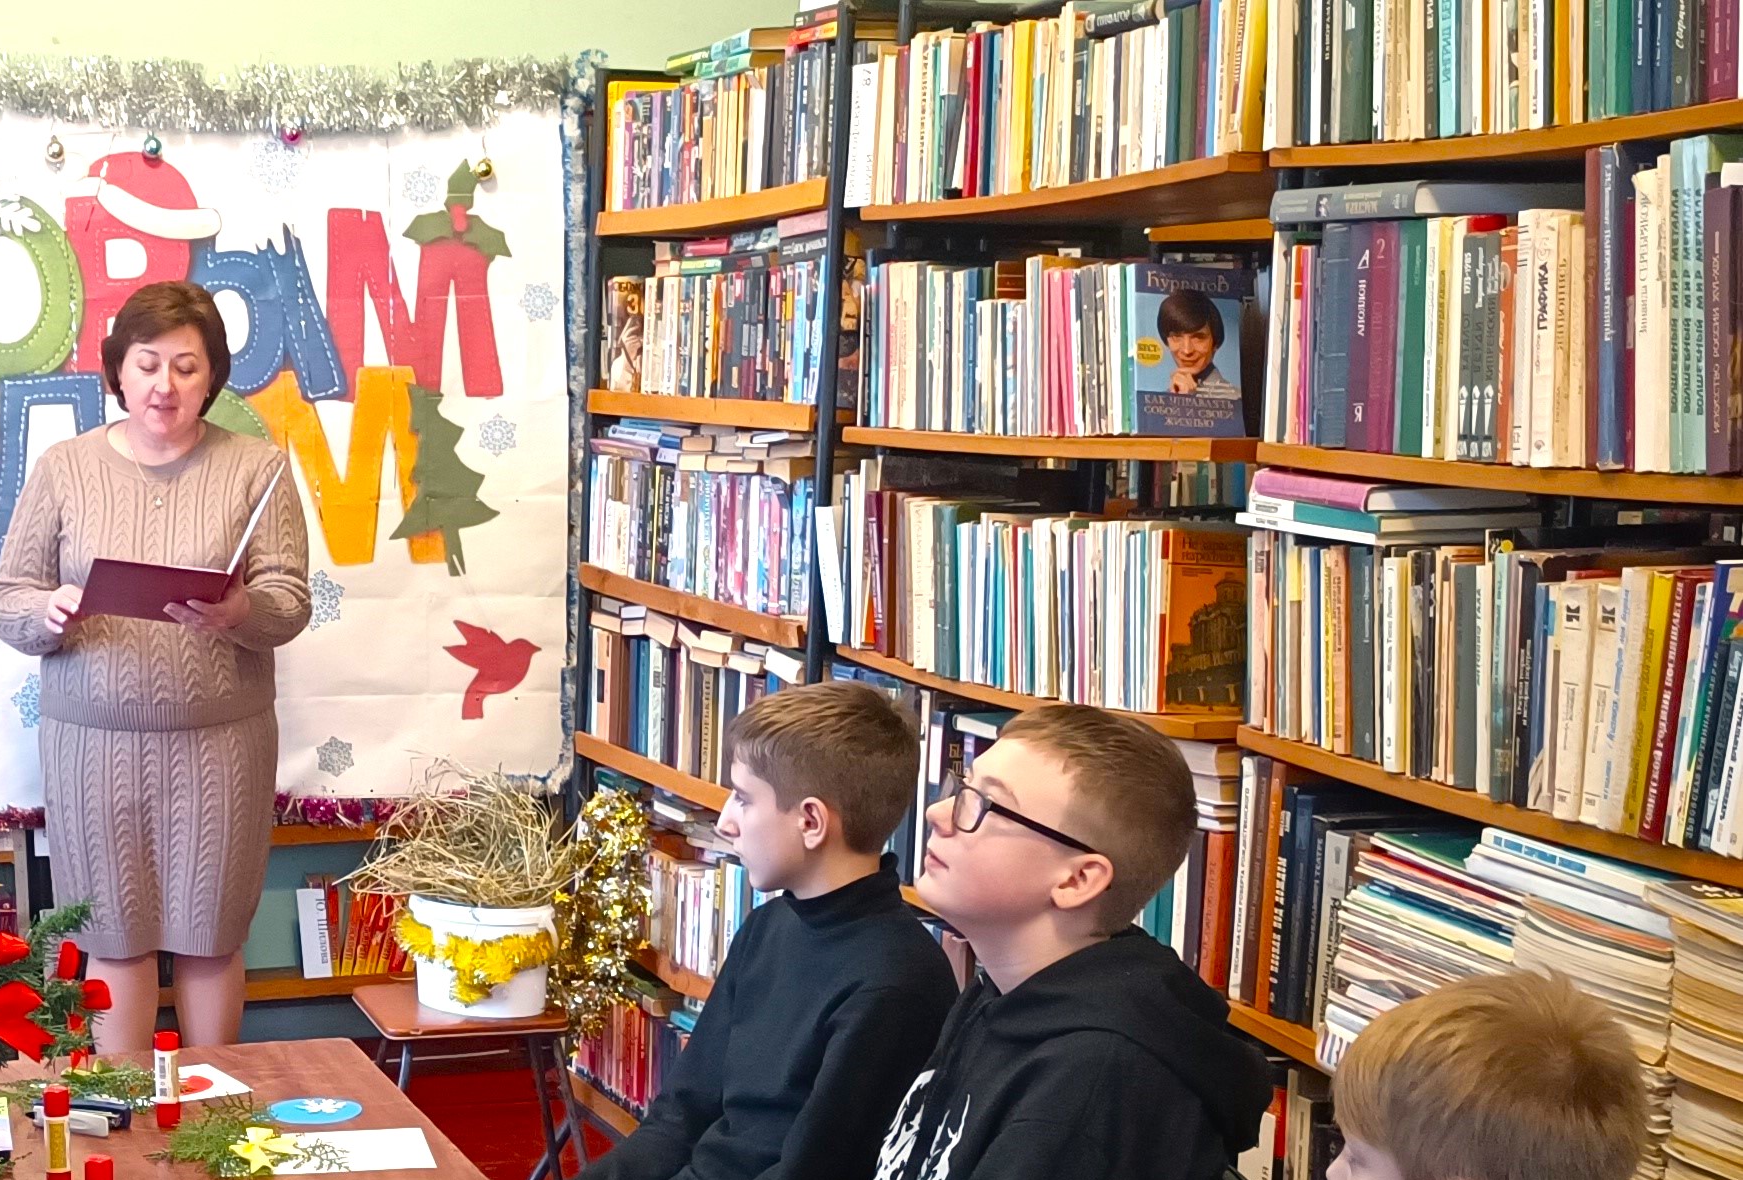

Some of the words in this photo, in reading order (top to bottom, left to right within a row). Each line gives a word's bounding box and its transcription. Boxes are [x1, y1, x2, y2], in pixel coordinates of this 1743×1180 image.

[1357, 280, 1367, 337] АПОЛЛОН
[1536, 261, 1549, 331] ГРАФИКА
[1641, 750, 1664, 830] СОВЕТСКОЙ
[1655, 689, 1672, 748] РОДИНЕ
[1664, 581, 1685, 688] ПОСВЯЩАЕТСЯ
[316, 918, 329, 965] Шилова
